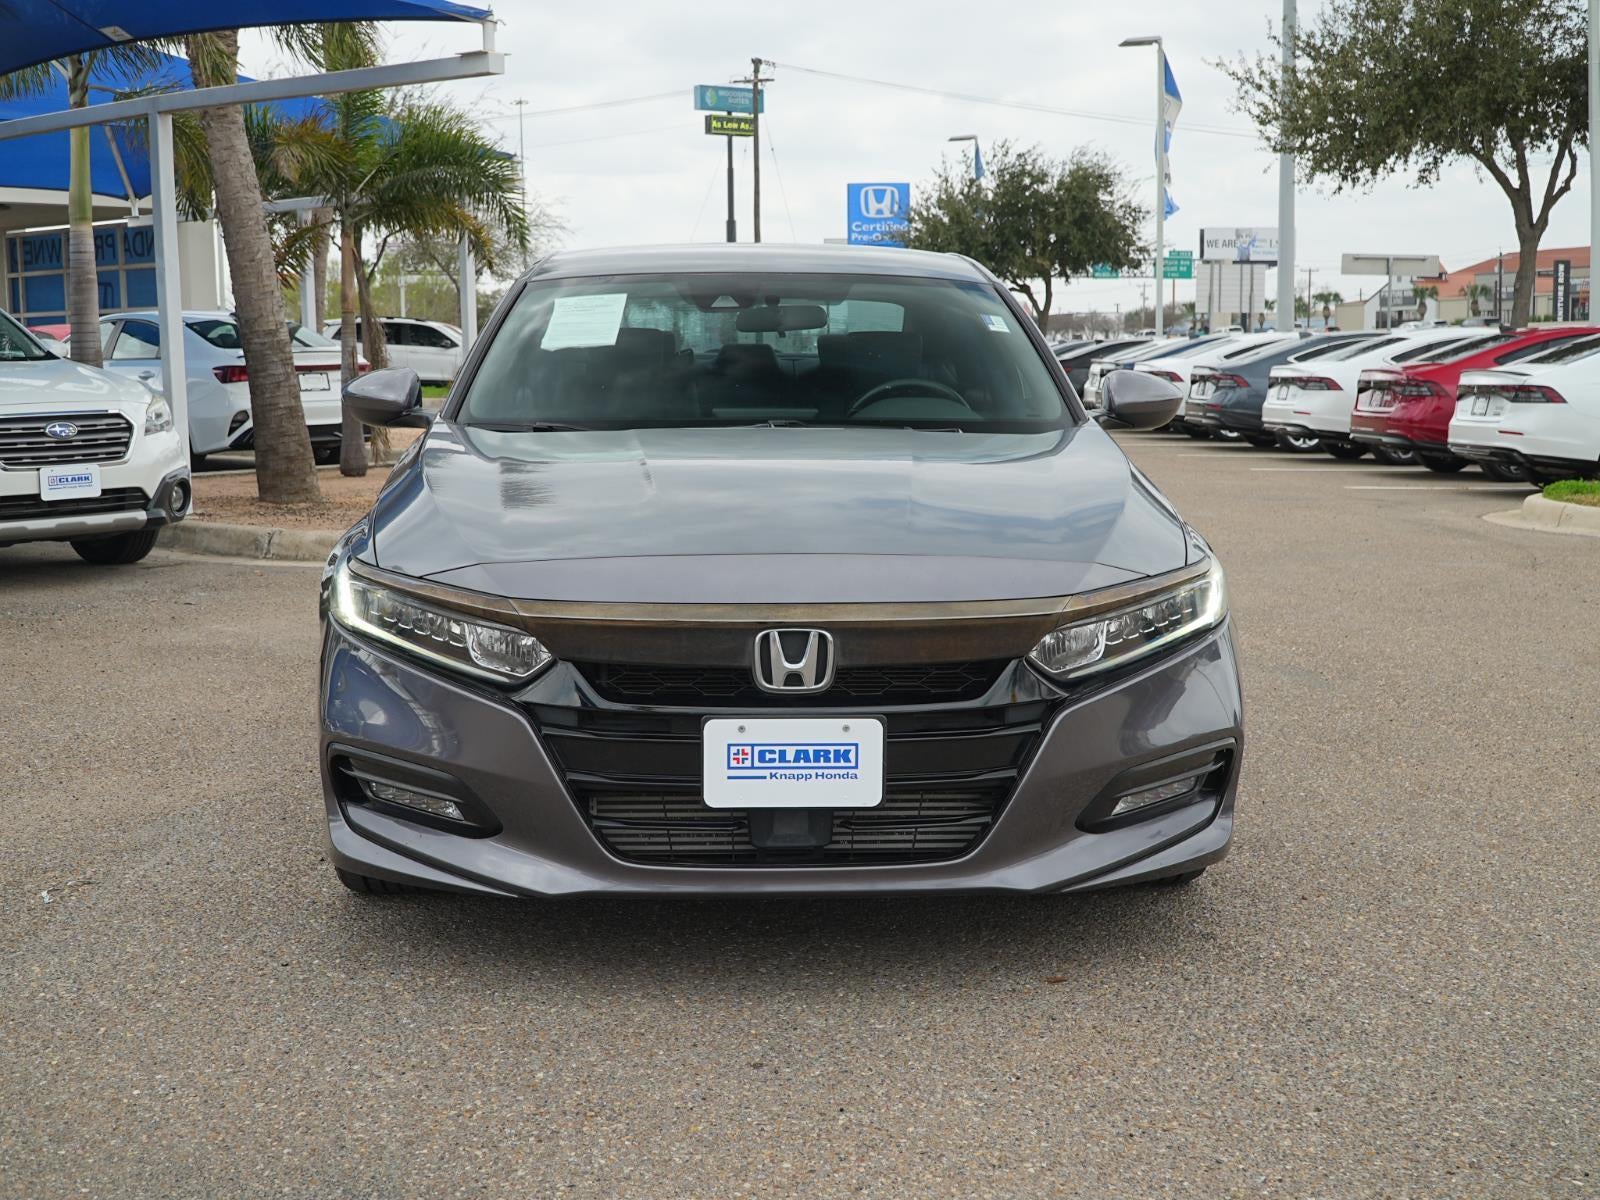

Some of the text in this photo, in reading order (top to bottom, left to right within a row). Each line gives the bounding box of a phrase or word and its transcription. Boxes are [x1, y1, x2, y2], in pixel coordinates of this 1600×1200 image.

[712, 120, 721, 128] As
[723, 121, 738, 129] Low
[852, 220, 909, 232] Certified
[1207, 239, 1220, 248] WE
[1222, 239, 1238, 248] ARE
[1557, 263, 1565, 283] ROW
[58, 475, 90, 483] CLARK
[757, 748, 853, 763] CLARK
[769, 772, 858, 782] Knapp Honda
